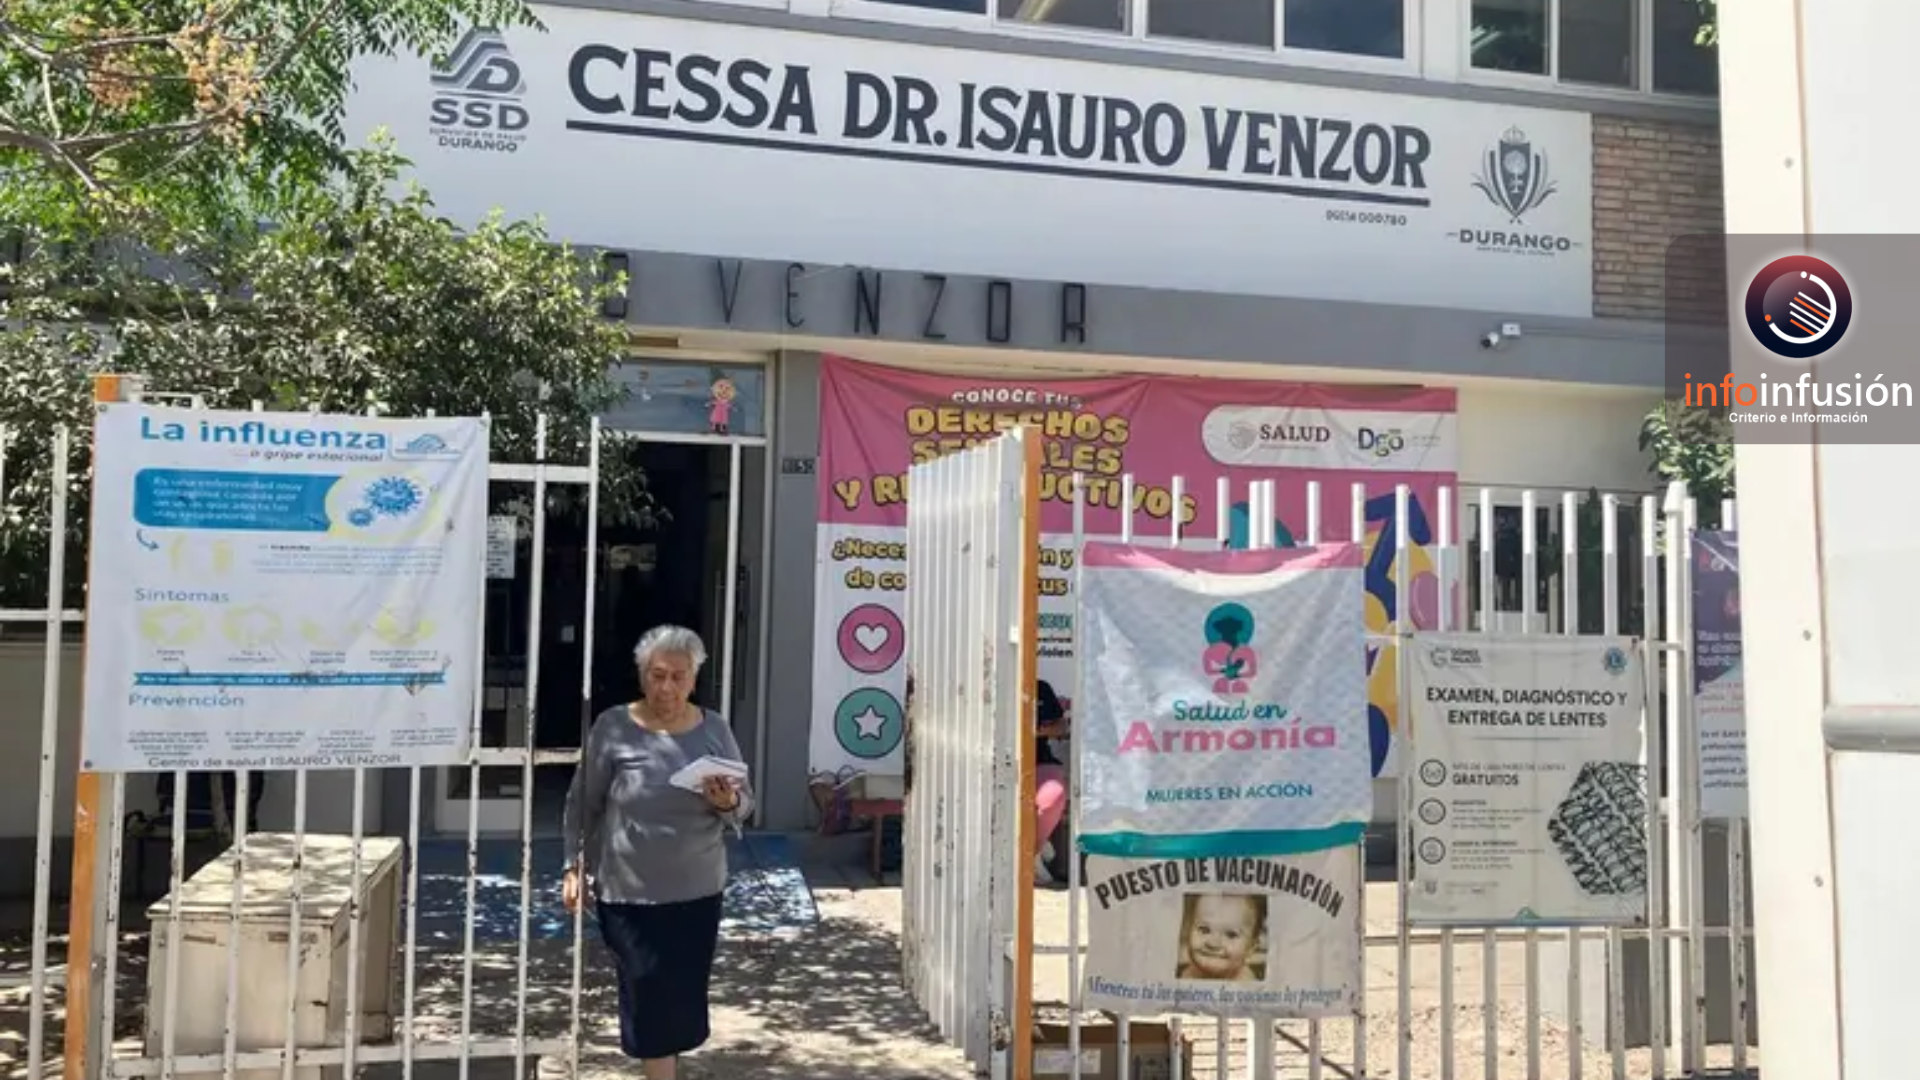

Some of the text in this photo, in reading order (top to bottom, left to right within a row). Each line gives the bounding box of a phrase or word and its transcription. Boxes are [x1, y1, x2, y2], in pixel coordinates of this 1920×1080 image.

[430, 98, 530, 131] SSD
[568, 44, 1431, 189] CESSA DR. ISAURO VENZOR
[438, 135, 518, 152] DURANGO
[1459, 229, 1571, 251] DURANGO
[717, 259, 1086, 344] VENZOR
[952, 388, 1037, 404] CONOCE
[140, 417, 387, 450] La influenza
[1259, 423, 1331, 442] SALUD
[263, 449, 304, 462] gripe
[307, 450, 383, 462] estacional
[832, 477, 864, 512] Y
[844, 566, 875, 589] de
[1426, 686, 1628, 706] EXAMEN, DIAGNÓSTICO Y
[1172, 699, 1288, 722] Salud en
[1447, 709, 1608, 728] ENTREGA DE LENTES
[1117, 717, 1337, 755] Armonía
[148, 754, 402, 768] Centro de salud ISAURO VENZOR
[1452, 773, 1520, 786] GRATUITOS
[1145, 782, 1313, 803] MUJERES EN ACCIÓN
[1094, 858, 1344, 918] PUESTO DE VACUNACIÓN
